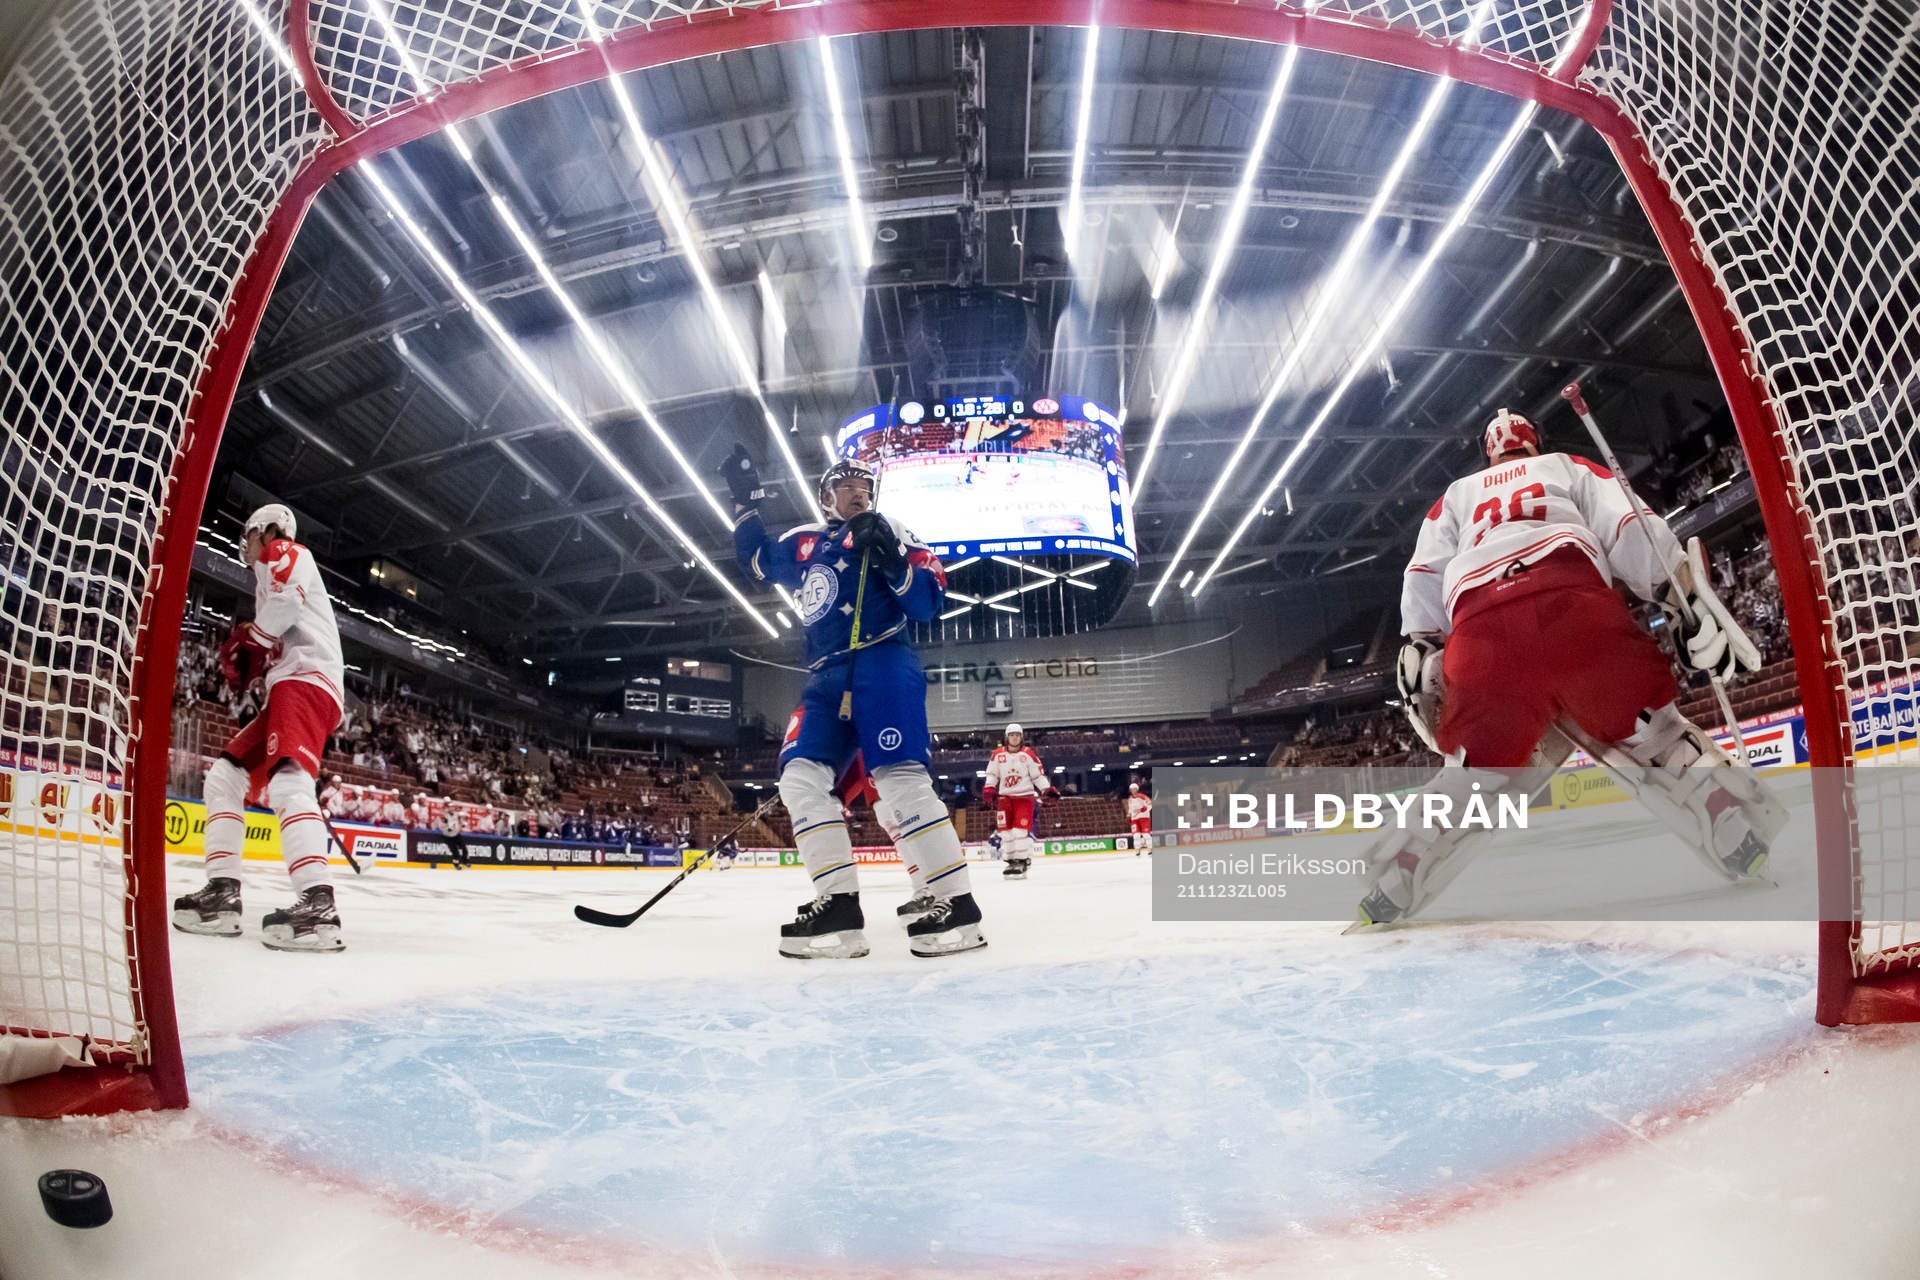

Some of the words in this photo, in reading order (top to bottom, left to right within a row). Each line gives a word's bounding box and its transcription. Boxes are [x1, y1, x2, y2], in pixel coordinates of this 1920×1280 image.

[1483, 463, 1527, 489] DAHM
[1013, 656, 1100, 680] arena
[357, 840, 398, 850] RADIAL
[1065, 839, 1107, 852] ŠKODA
[510, 846, 548, 861] CHAMPIONS
[853, 851, 903, 863] STRAUSS
